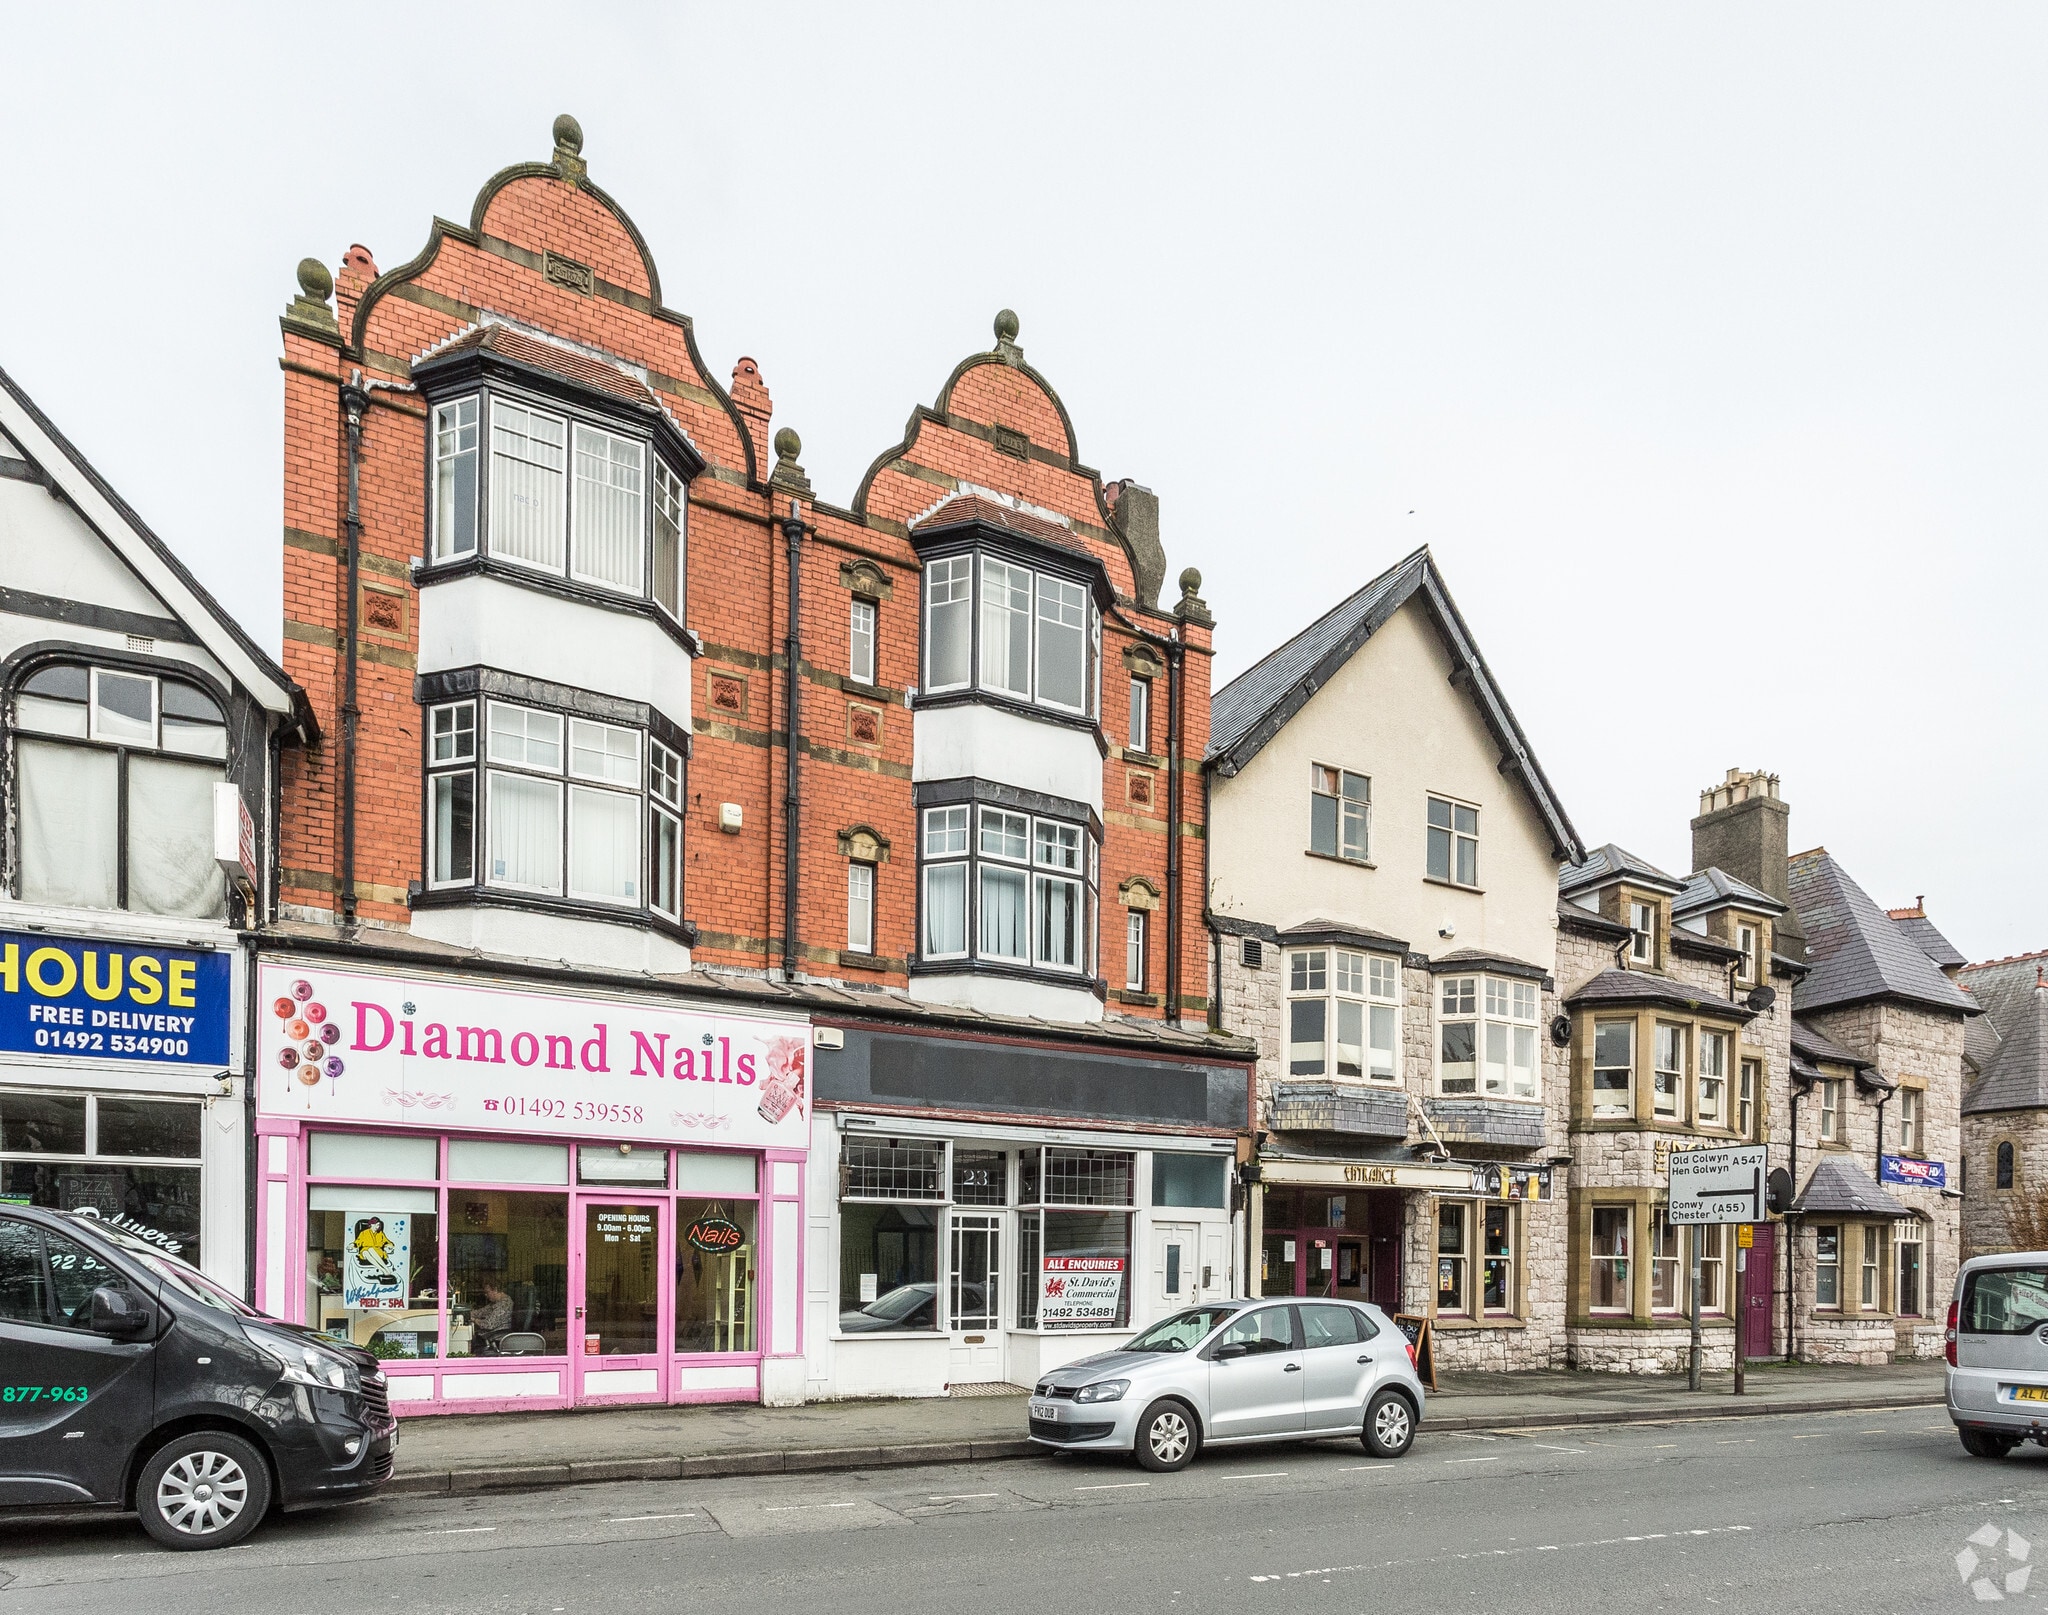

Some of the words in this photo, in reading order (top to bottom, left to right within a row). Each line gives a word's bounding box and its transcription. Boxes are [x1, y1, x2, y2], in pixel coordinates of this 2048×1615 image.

[513, 493, 539, 507] naco
[30, 1005, 84, 1026] FREE
[92, 1010, 195, 1034] DELIVERY
[35, 1029, 104, 1051] 01492
[110, 1034, 189, 1056] 534900
[350, 1001, 611, 1073] Diamond
[630, 1030, 756, 1086] Nails
[504, 1096, 566, 1118] 01492
[573, 1101, 644, 1124] 539558
[1672, 1155, 1689, 1165] Old
[1692, 1154, 1729, 1163] Colwyn
[1732, 1155, 1763, 1166] A547
[1672, 1167, 1690, 1176] Hen
[1692, 1165, 1729, 1174] Golwyn
[963, 1169, 988, 1186] 23
[69, 1179, 113, 1193] PIZZA
[67, 1196, 119, 1209] KEBAB
[1671, 1200, 1704, 1210] Conwy
[1712, 1202, 1746, 1214] (A55)
[598, 1213, 627, 1222] OPENING
[628, 1214, 650, 1223] HOURS
[1671, 1210, 1711, 1220] Chester
[604, 1233, 620, 1242] Mon
[629, 1233, 641, 1242] Sat
[688, 1224, 741, 1246] Nails
[1047, 1259, 1066, 1270] ALL
[1067, 1259, 1119, 1271] ENQUIRIES
[1067, 1276, 1080, 1287] St.
[1081, 1276, 1116, 1287] David's
[1065, 1289, 1117, 1299] Commercial
[388, 1298, 405, 1309] SPA
[1043, 1307, 1073, 1317] 01492
[1075, 1307, 1115, 1317] 534881
[1044, 1321, 1112, 1329] ww.stdavidsproperty.com
[2, 1386, 89, 1403] 877-963
